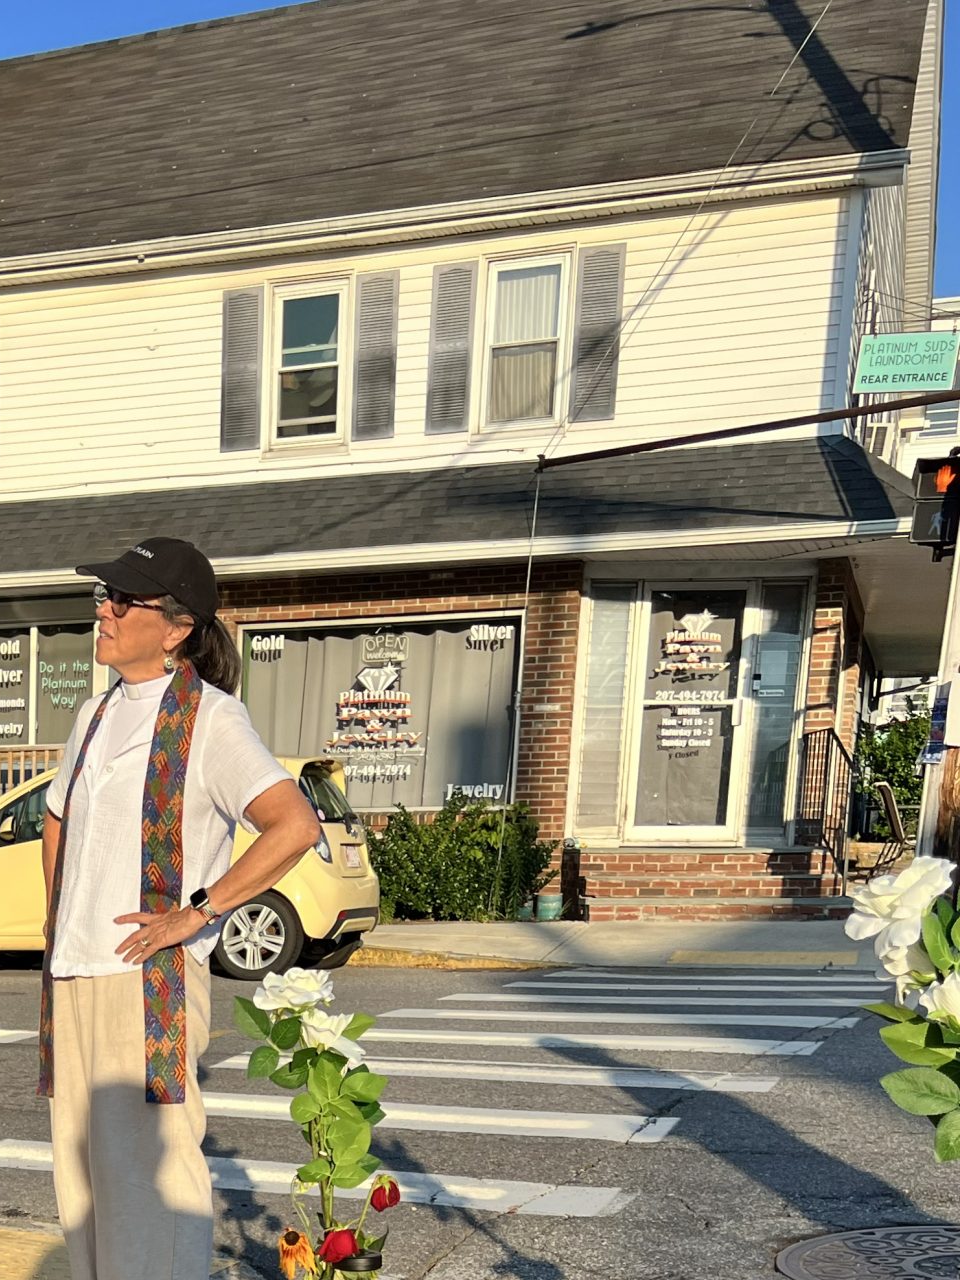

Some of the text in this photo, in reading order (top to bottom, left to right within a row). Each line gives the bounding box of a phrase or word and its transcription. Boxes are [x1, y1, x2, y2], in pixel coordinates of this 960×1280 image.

[863, 340, 956, 355] PLATINUM SUDS
[869, 353, 945, 367] LAUNDROMAT
[860, 372, 948, 384] REAR ENTRANCE
[470, 624, 515, 640] Silver
[666, 630, 722, 643] Platinum
[251, 634, 285, 651] Gold
[365, 634, 406, 651] OPEN
[666, 644, 722, 654] Pawn
[686, 653, 700, 663] &
[39, 660, 90, 673] Do it the
[654, 660, 730, 672] Jewelry
[42, 678, 87, 689] Platinum
[50, 694, 77, 708] Way!
[339, 689, 412, 704] Platinum
[655, 690, 725, 700] 207-494-7974
[340, 707, 414, 720] Pawn
[366, 719, 383, 733] &
[662, 718, 677, 726] Mon
[326, 730, 423, 746] Jewelry
[661, 728, 692, 737] Saturday
[661, 739, 711, 747] Sunday Closed
[344, 764, 411, 776] 07-494-7974
